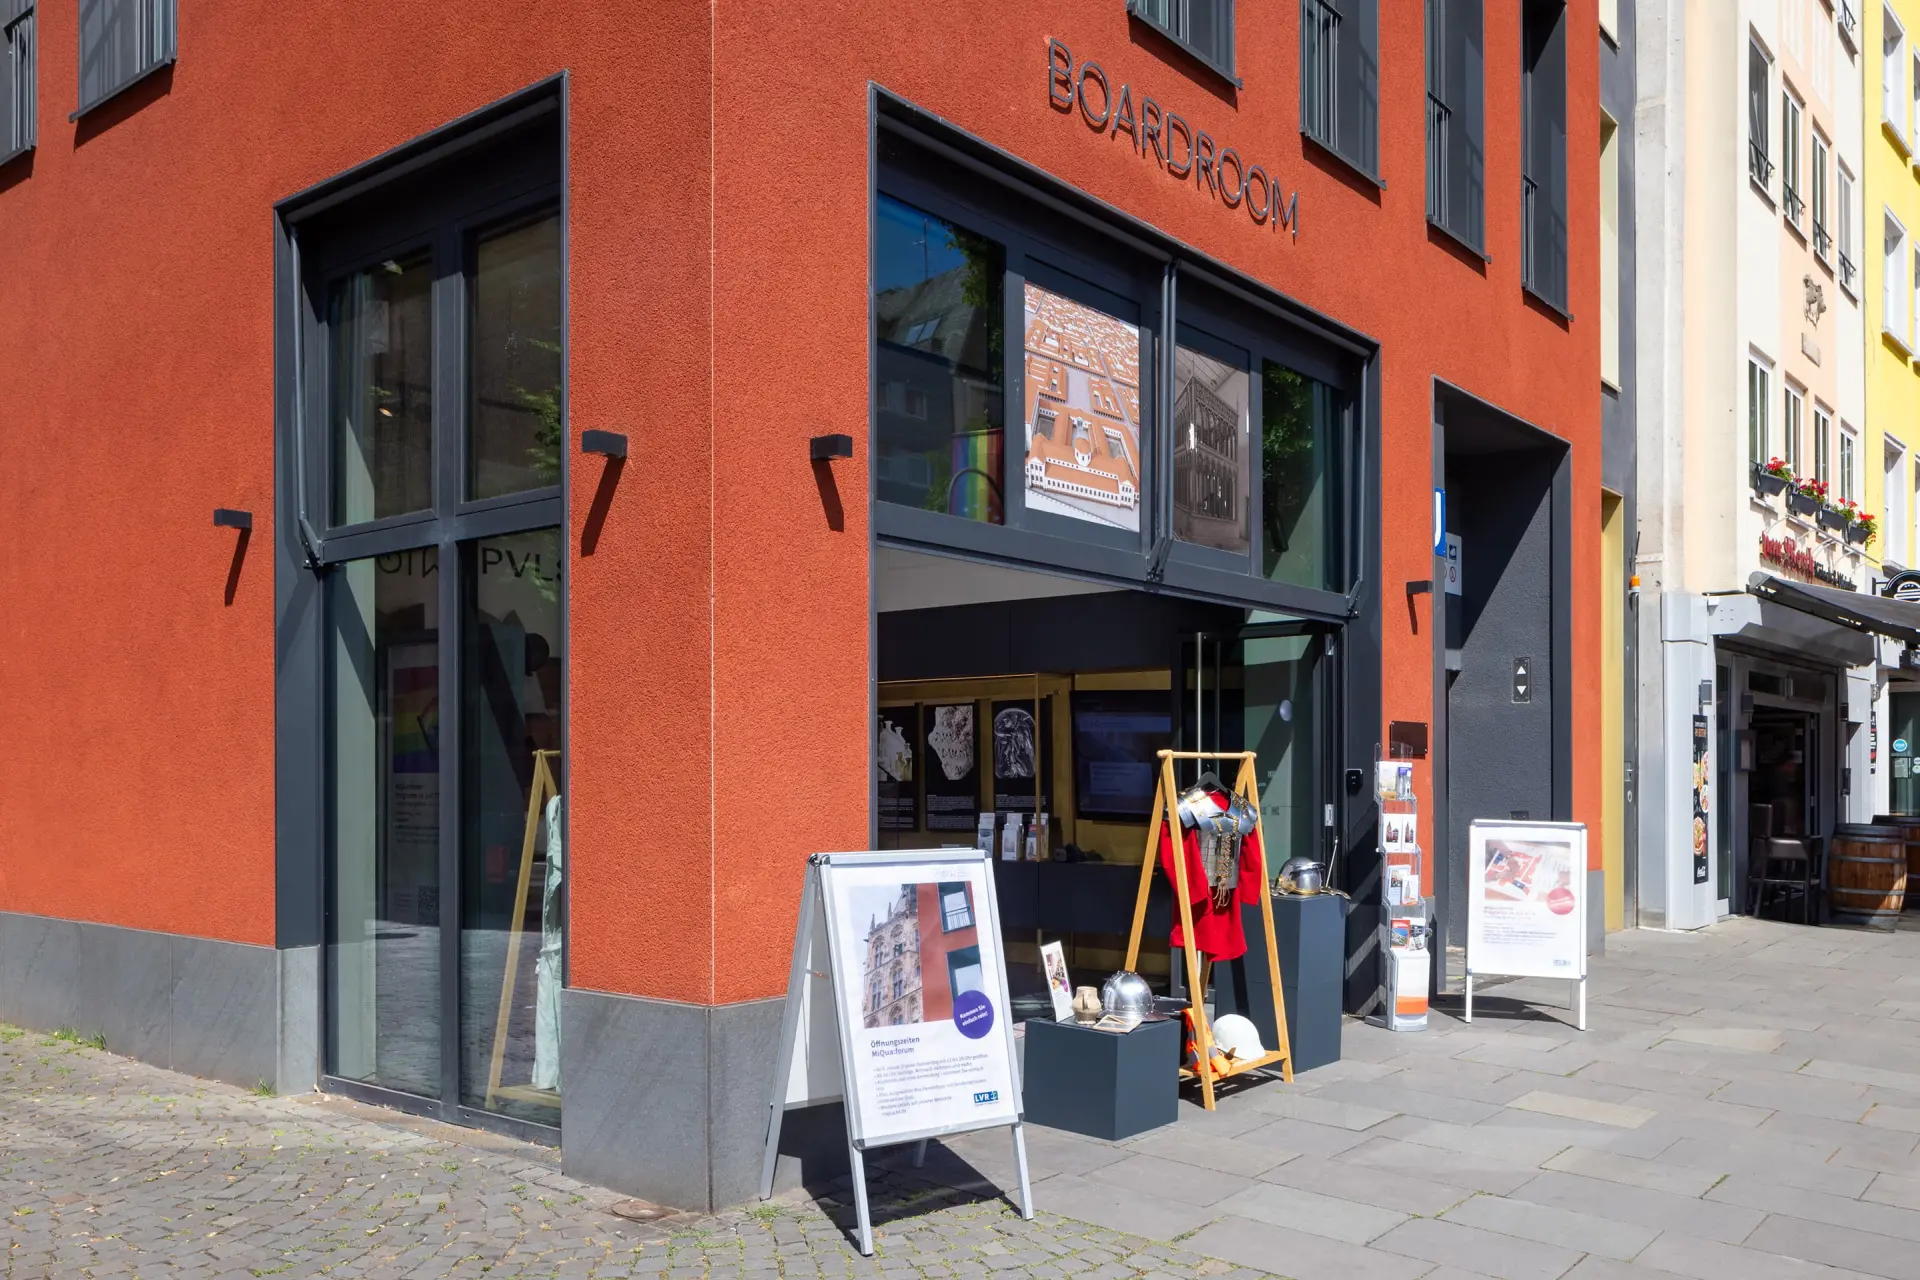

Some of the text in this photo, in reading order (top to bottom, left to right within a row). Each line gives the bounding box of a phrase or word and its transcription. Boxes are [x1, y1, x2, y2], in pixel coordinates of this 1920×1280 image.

[1049, 37, 1298, 236] BOARDROOM
[870, 1037, 920, 1048] Öffnungszeiten
[974, 1093, 990, 1103] LVR
